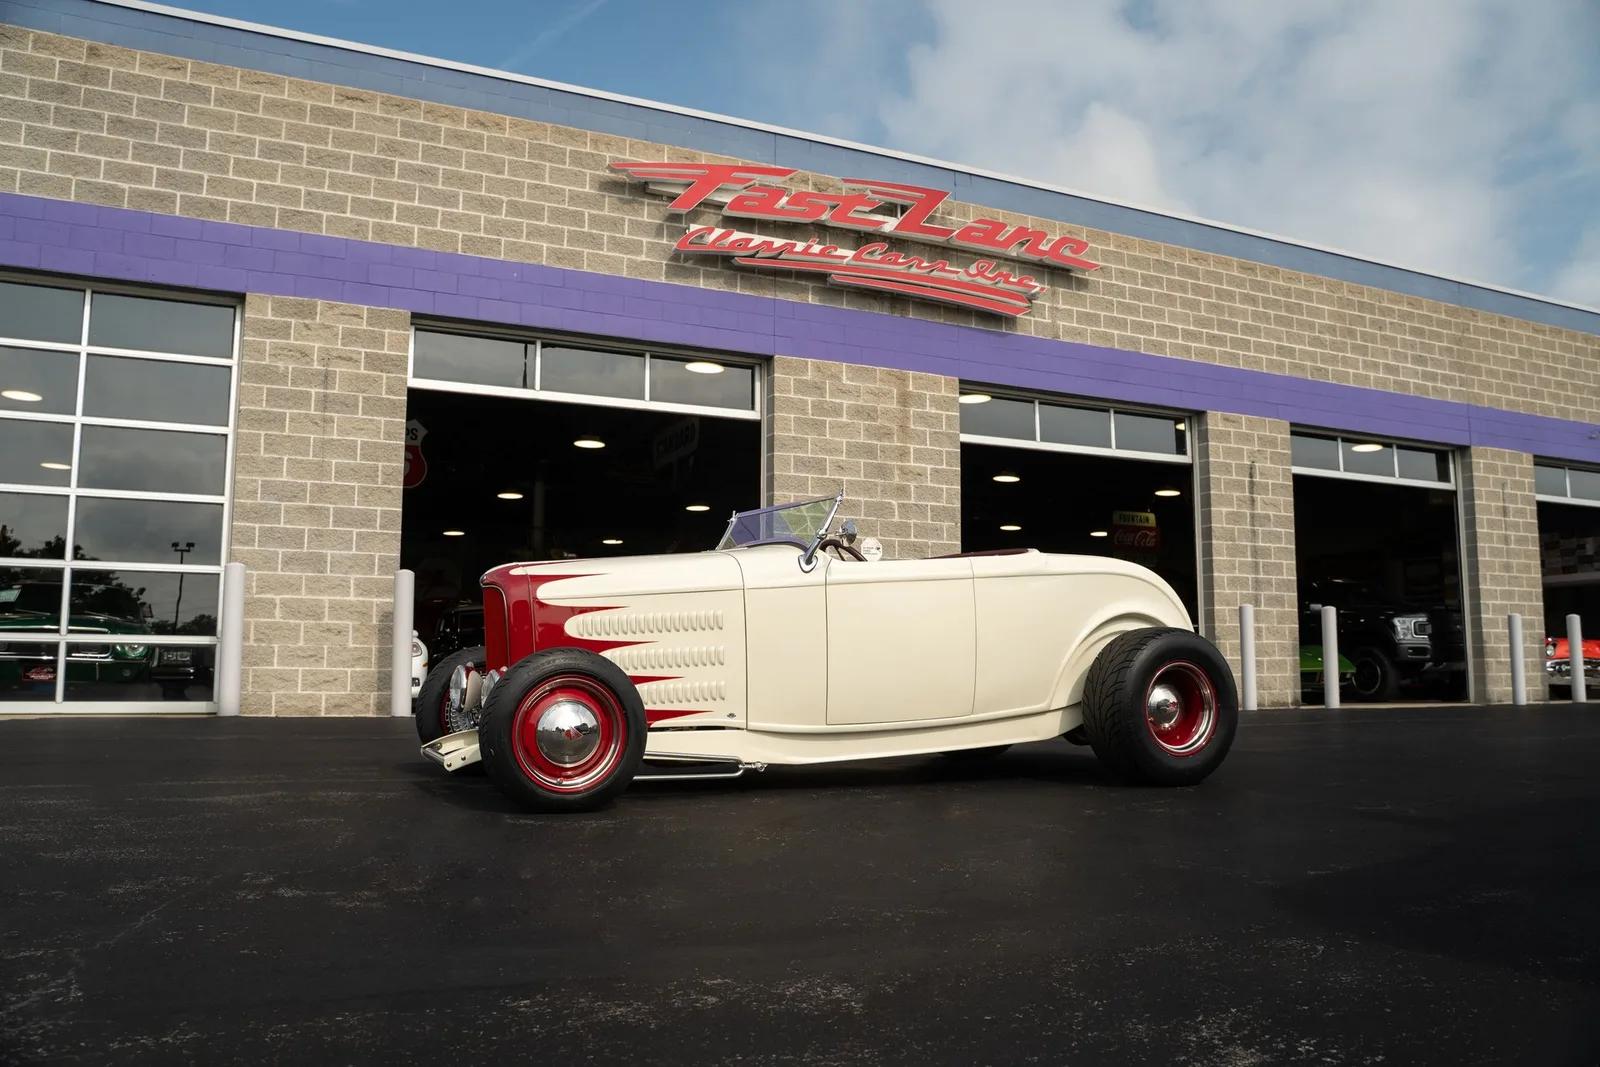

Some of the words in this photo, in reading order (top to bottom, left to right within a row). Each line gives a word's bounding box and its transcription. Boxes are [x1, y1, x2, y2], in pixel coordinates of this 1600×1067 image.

[609, 162, 884, 230] Fast
[841, 178, 1100, 271] Lane
[674, 226, 848, 260] Classic
[852, 242, 961, 276] Cars
